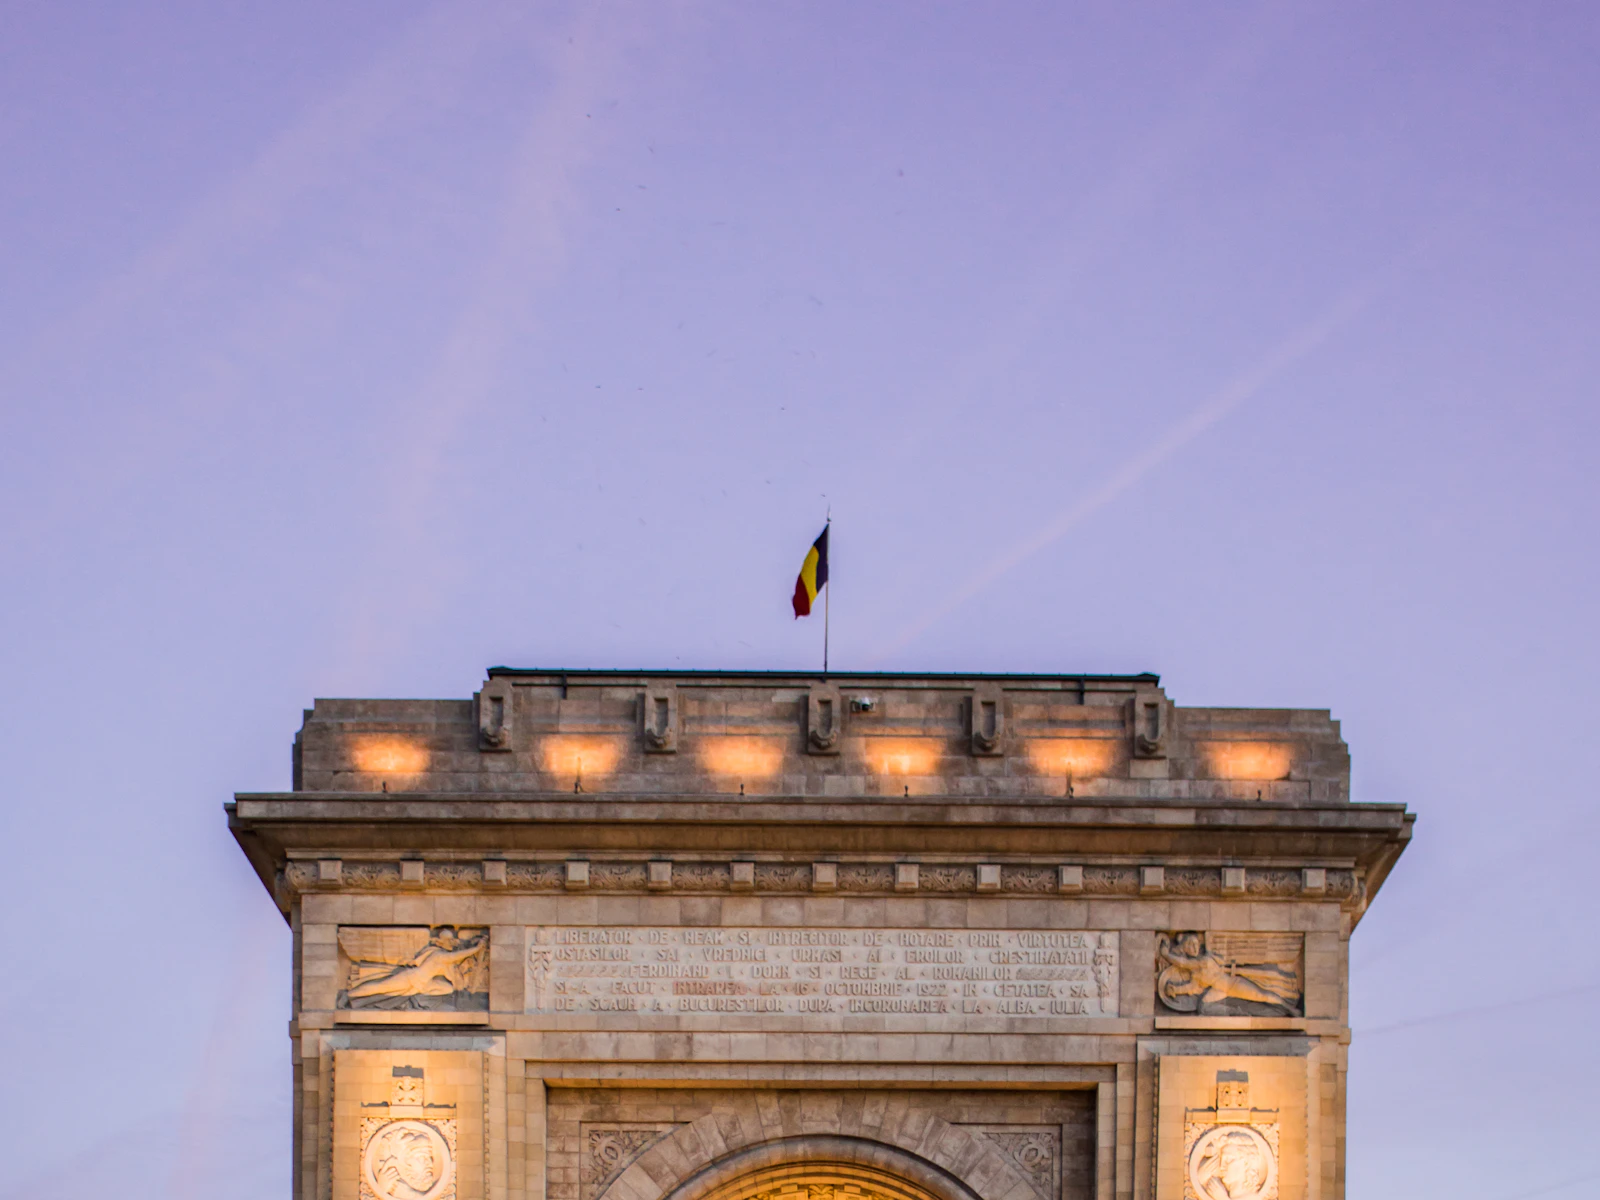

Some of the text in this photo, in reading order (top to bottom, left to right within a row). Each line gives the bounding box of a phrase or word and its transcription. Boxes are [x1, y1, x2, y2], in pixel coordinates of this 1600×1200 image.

[556, 931, 632, 945] LIBERATOR
[650, 931, 669, 945] DE
[684, 931, 726, 945] NEAM
[863, 932, 883, 947] DE
[899, 932, 954, 947] HOTARE
[968, 933, 1001, 948] PRIN
[1017, 933, 1088, 948] VIRTUTEA
[905, 949, 964, 964] EROILOR
[630, 964, 710, 978] FERDINAND
[752, 965, 791, 979] DOMN
[839, 966, 878, 980] REGE
[895, 966, 915, 980] AL
[672, 981, 748, 996] INTRAREA
[759, 982, 780, 996] LA
[795, 982, 810, 996] 16
[824, 982, 902, 997] OCTOMBRIE
[916, 983, 949, 997] 1922
[993, 983, 1057, 998] CETATEA
[1070, 984, 1090, 998] SA
[555, 998, 575, 1012] DE
[590, 998, 637, 1012] SCAUN
[652, 998, 666, 1012] A
[850, 999, 949, 1014] INCORONAREA
[962, 1000, 984, 1014] LA
